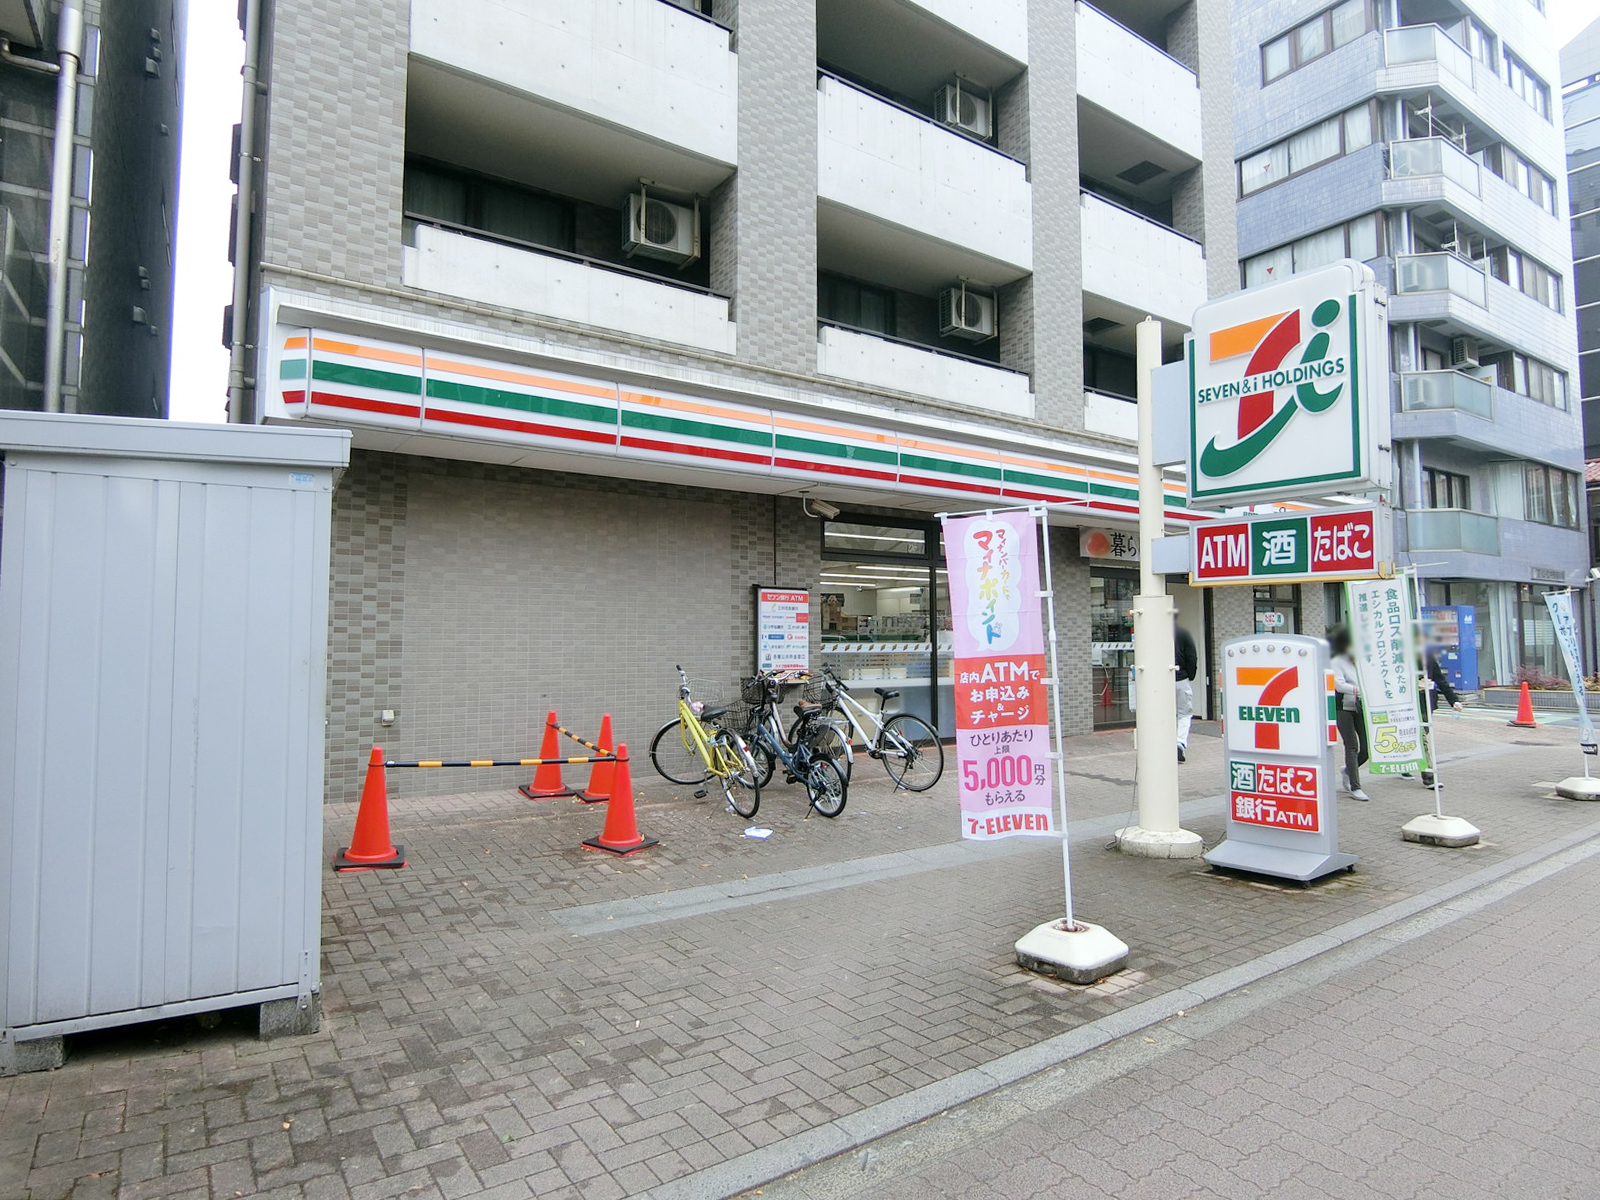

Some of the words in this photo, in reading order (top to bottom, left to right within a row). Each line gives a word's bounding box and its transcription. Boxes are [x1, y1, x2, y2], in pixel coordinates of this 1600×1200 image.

[1262, 357, 1346, 389] HOLDINGS
[1110, 532, 1139, 558] 暮ら
[1200, 532, 1247, 570] ATM
[1261, 529, 1297, 567] 酒
[1312, 522, 1373, 562] たばこ
[973, 530, 1002, 645] マイナポイント
[1385, 588, 1407, 695] 食品ロス削減のため
[960, 661, 1041, 684] 店内ATMで
[970, 686, 1030, 703] お申込み
[997, 702, 1005, 711] &
[970, 705, 1030, 725] チャージ
[970, 729, 1034, 747] ひとりあたり
[994, 744, 1011, 755] 上限
[963, 755, 1032, 792] 5,000
[1231, 763, 1255, 792] 酒
[1258, 765, 1315, 796] たばこ
[985, 789, 1026, 806] もらえる
[1235, 797, 1313, 828] 銀行ATM
